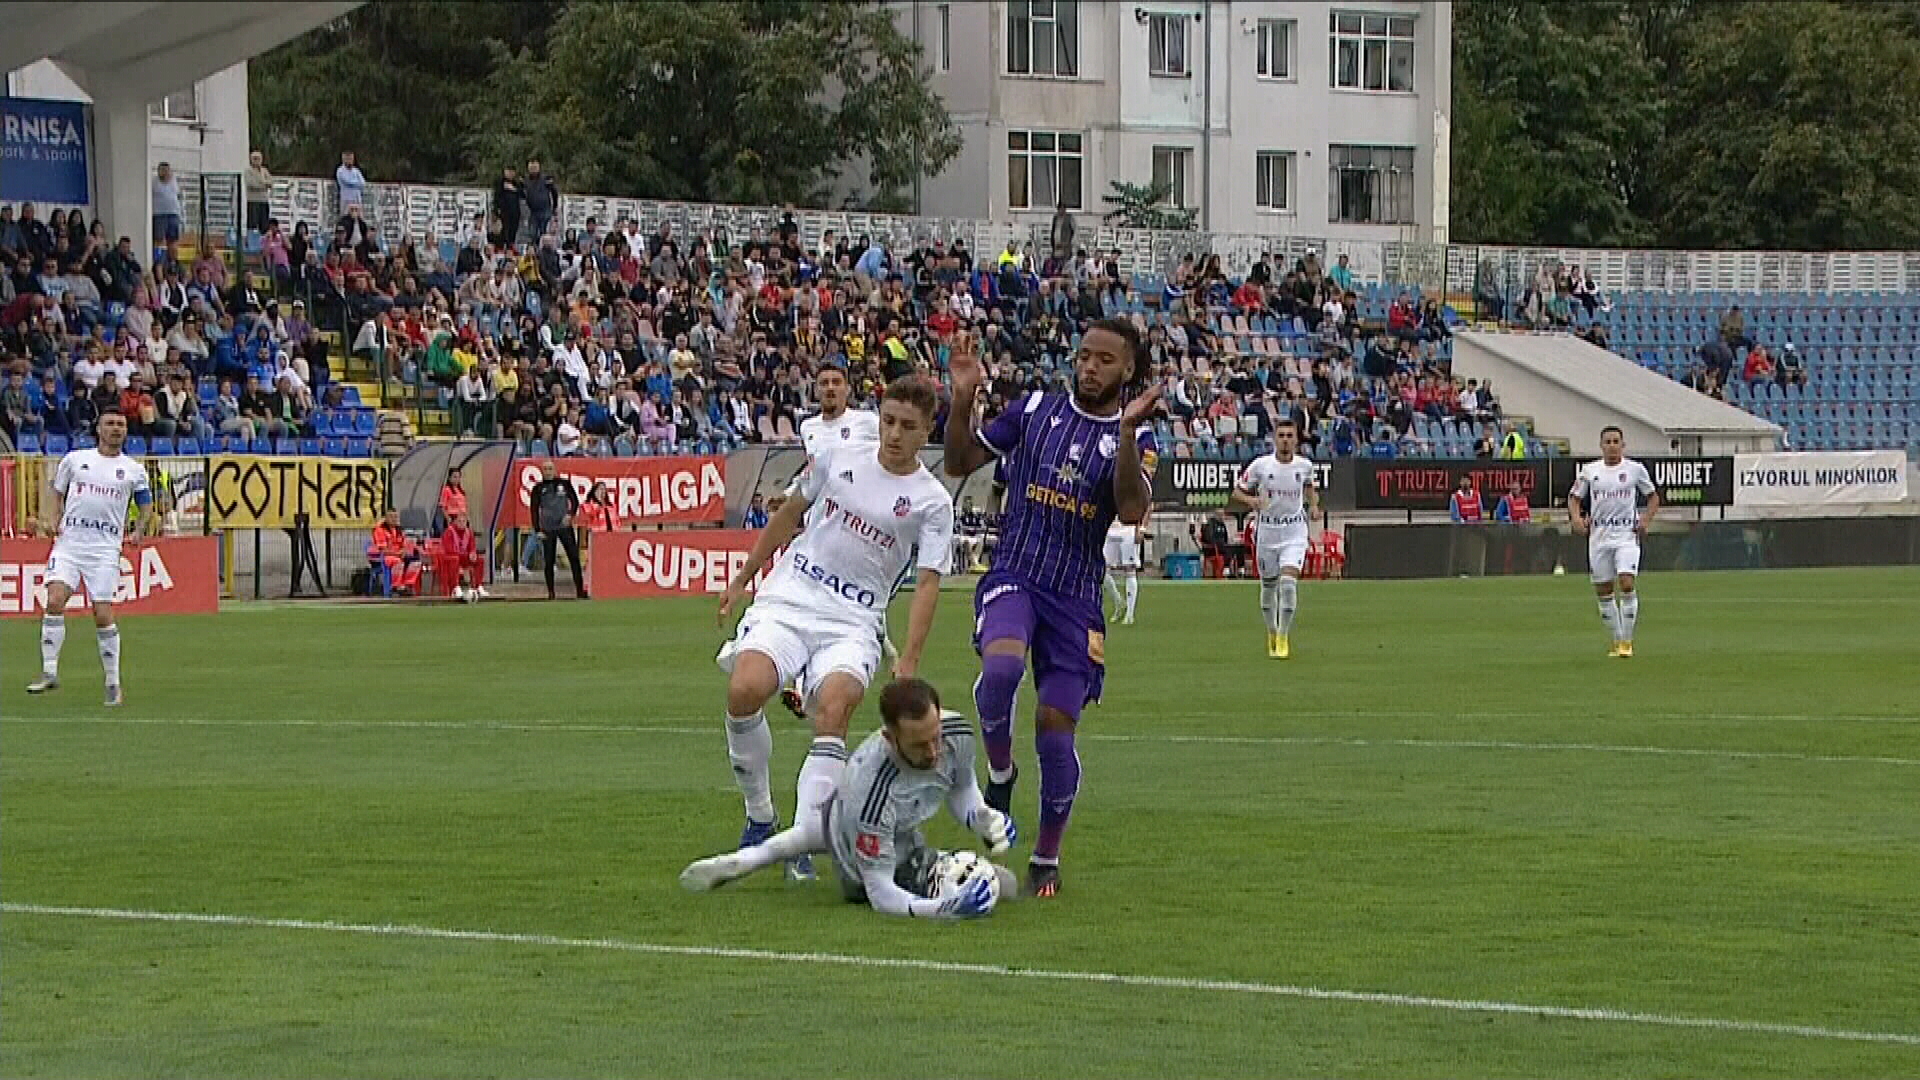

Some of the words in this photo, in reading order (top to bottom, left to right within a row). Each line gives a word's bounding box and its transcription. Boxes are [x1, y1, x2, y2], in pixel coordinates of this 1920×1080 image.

[1173, 463, 1242, 489] UNIBET
[1395, 469, 1449, 489] TRUTZI
[1486, 469, 1535, 489] TRUTZI
[1655, 462, 1713, 486] UNIBET
[1740, 469, 1811, 487] IZVORUL
[1815, 467, 1898, 486] MINUNILOR
[1026, 483, 1077, 513] GETICA
[843, 510, 896, 549] TRUTZI
[794, 553, 875, 608] ELSACO
